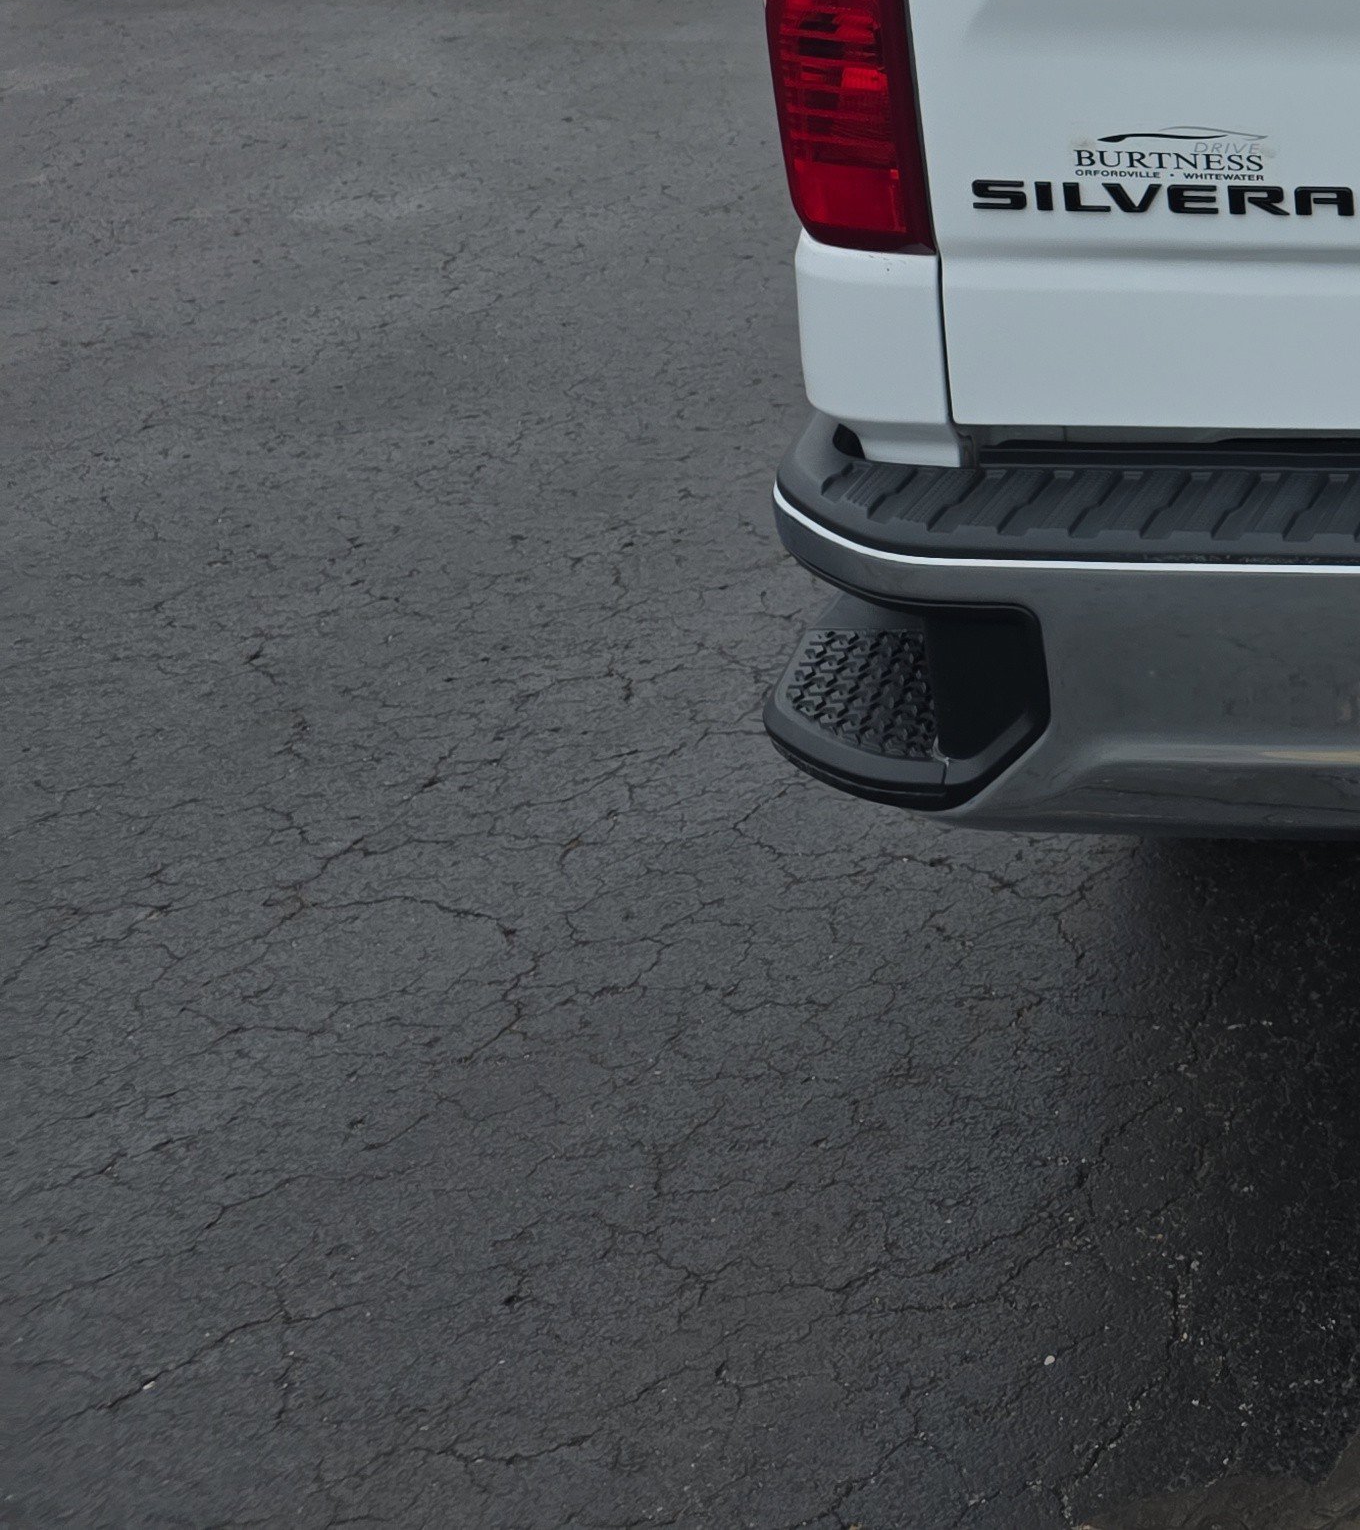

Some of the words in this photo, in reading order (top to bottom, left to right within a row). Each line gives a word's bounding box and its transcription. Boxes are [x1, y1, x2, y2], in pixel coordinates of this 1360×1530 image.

[1194, 141, 1261, 154] DRIVE
[1074, 148, 1264, 172] BURTNESS
[1074, 169, 1161, 179] ORFORDVILLE
[1183, 172, 1265, 182] WHITEWATER
